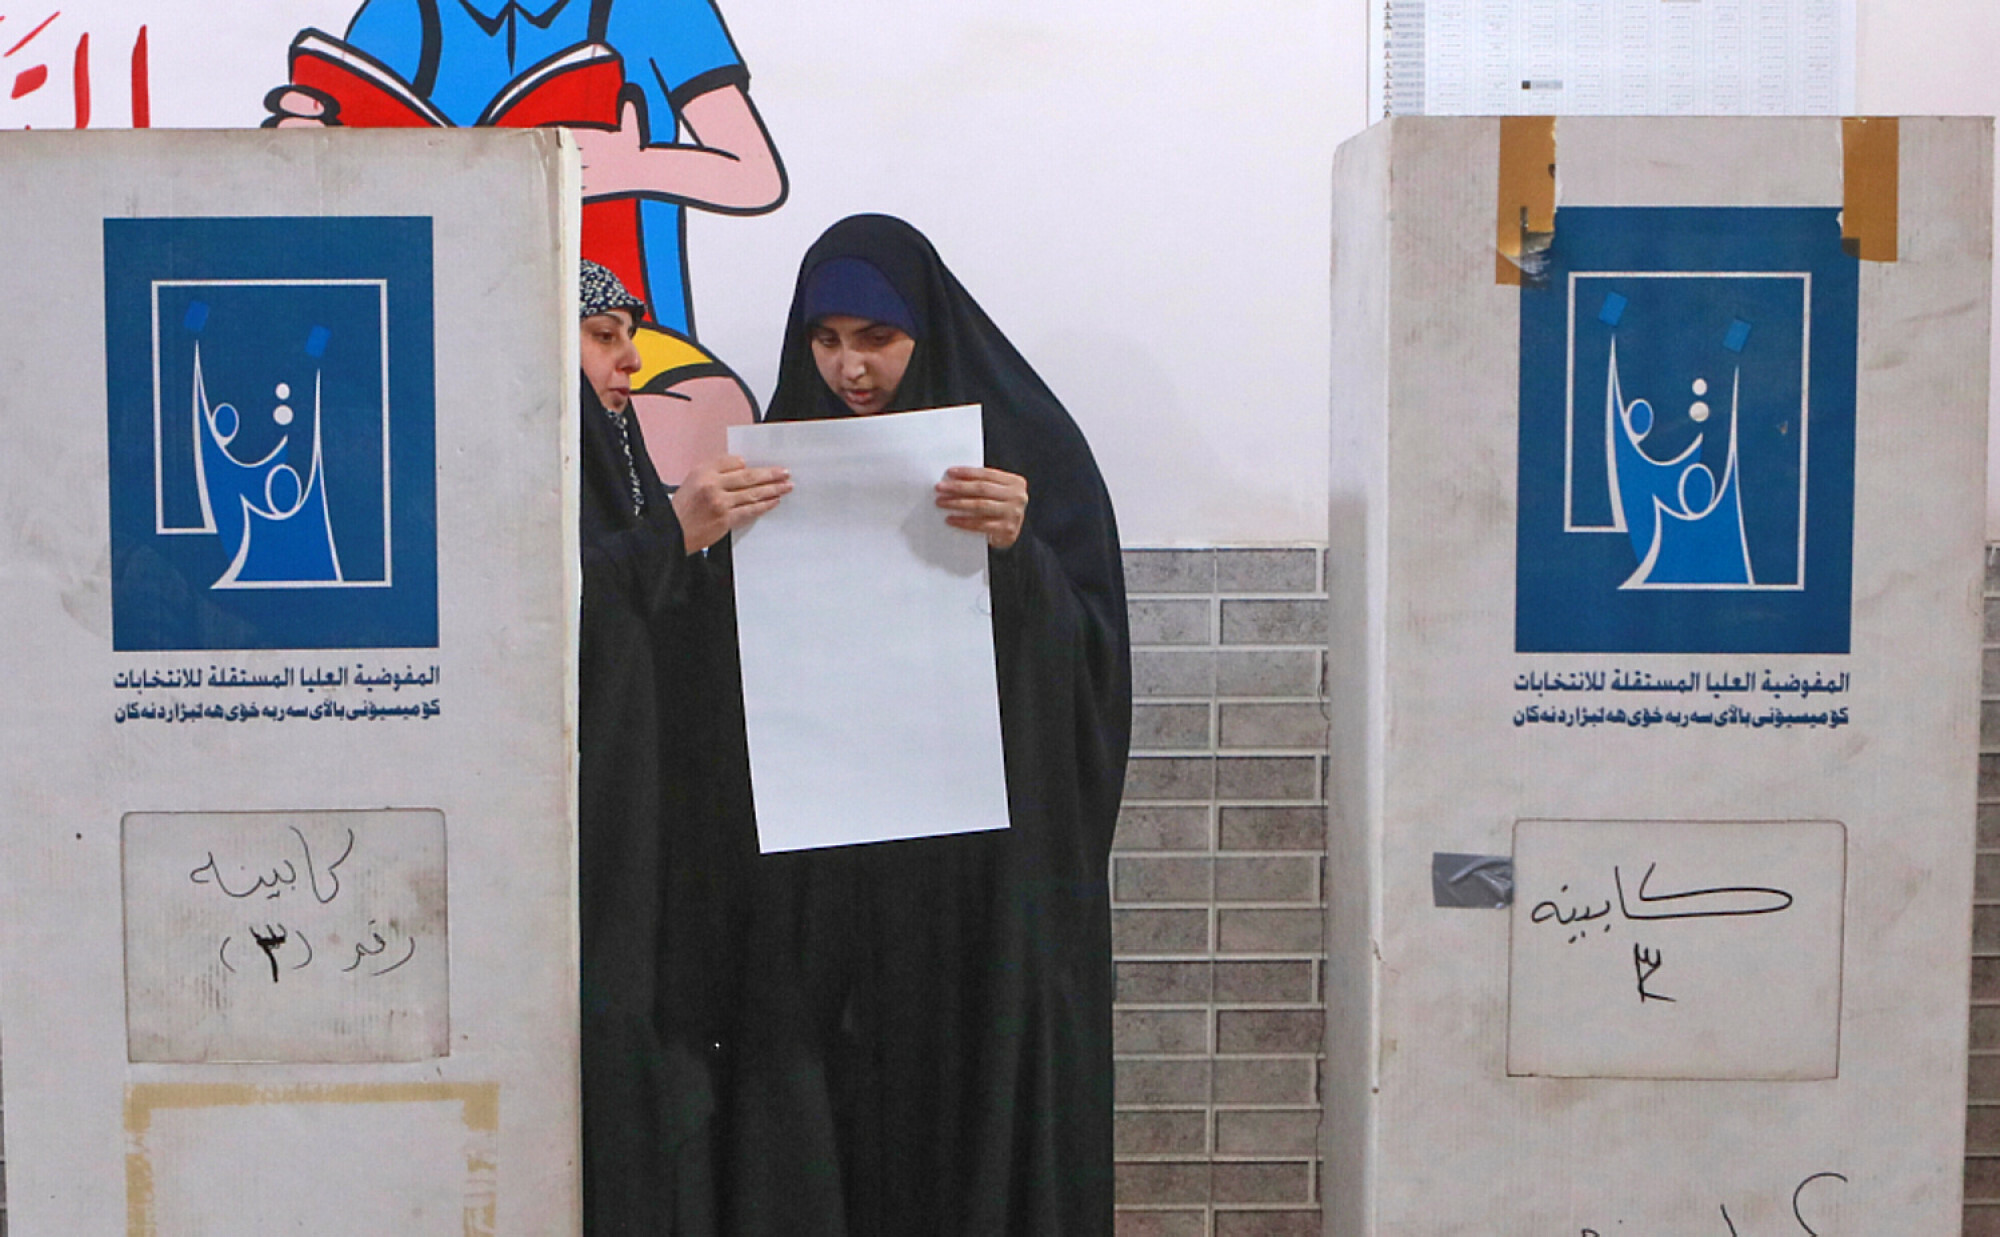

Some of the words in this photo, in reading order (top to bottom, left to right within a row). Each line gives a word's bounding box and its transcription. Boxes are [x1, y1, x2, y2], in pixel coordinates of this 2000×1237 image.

[113, 667, 202, 694] للانتخابات
[207, 664, 294, 688] المستقلة
[300, 666, 348, 692] العليا
[353, 663, 441, 692] المفوضية
[1513, 670, 1606, 697] للانتخابات
[1611, 668, 1700, 693] المستقلة
[1706, 671, 1756, 698] العليا
[1761, 669, 1851, 698] المفوضية
